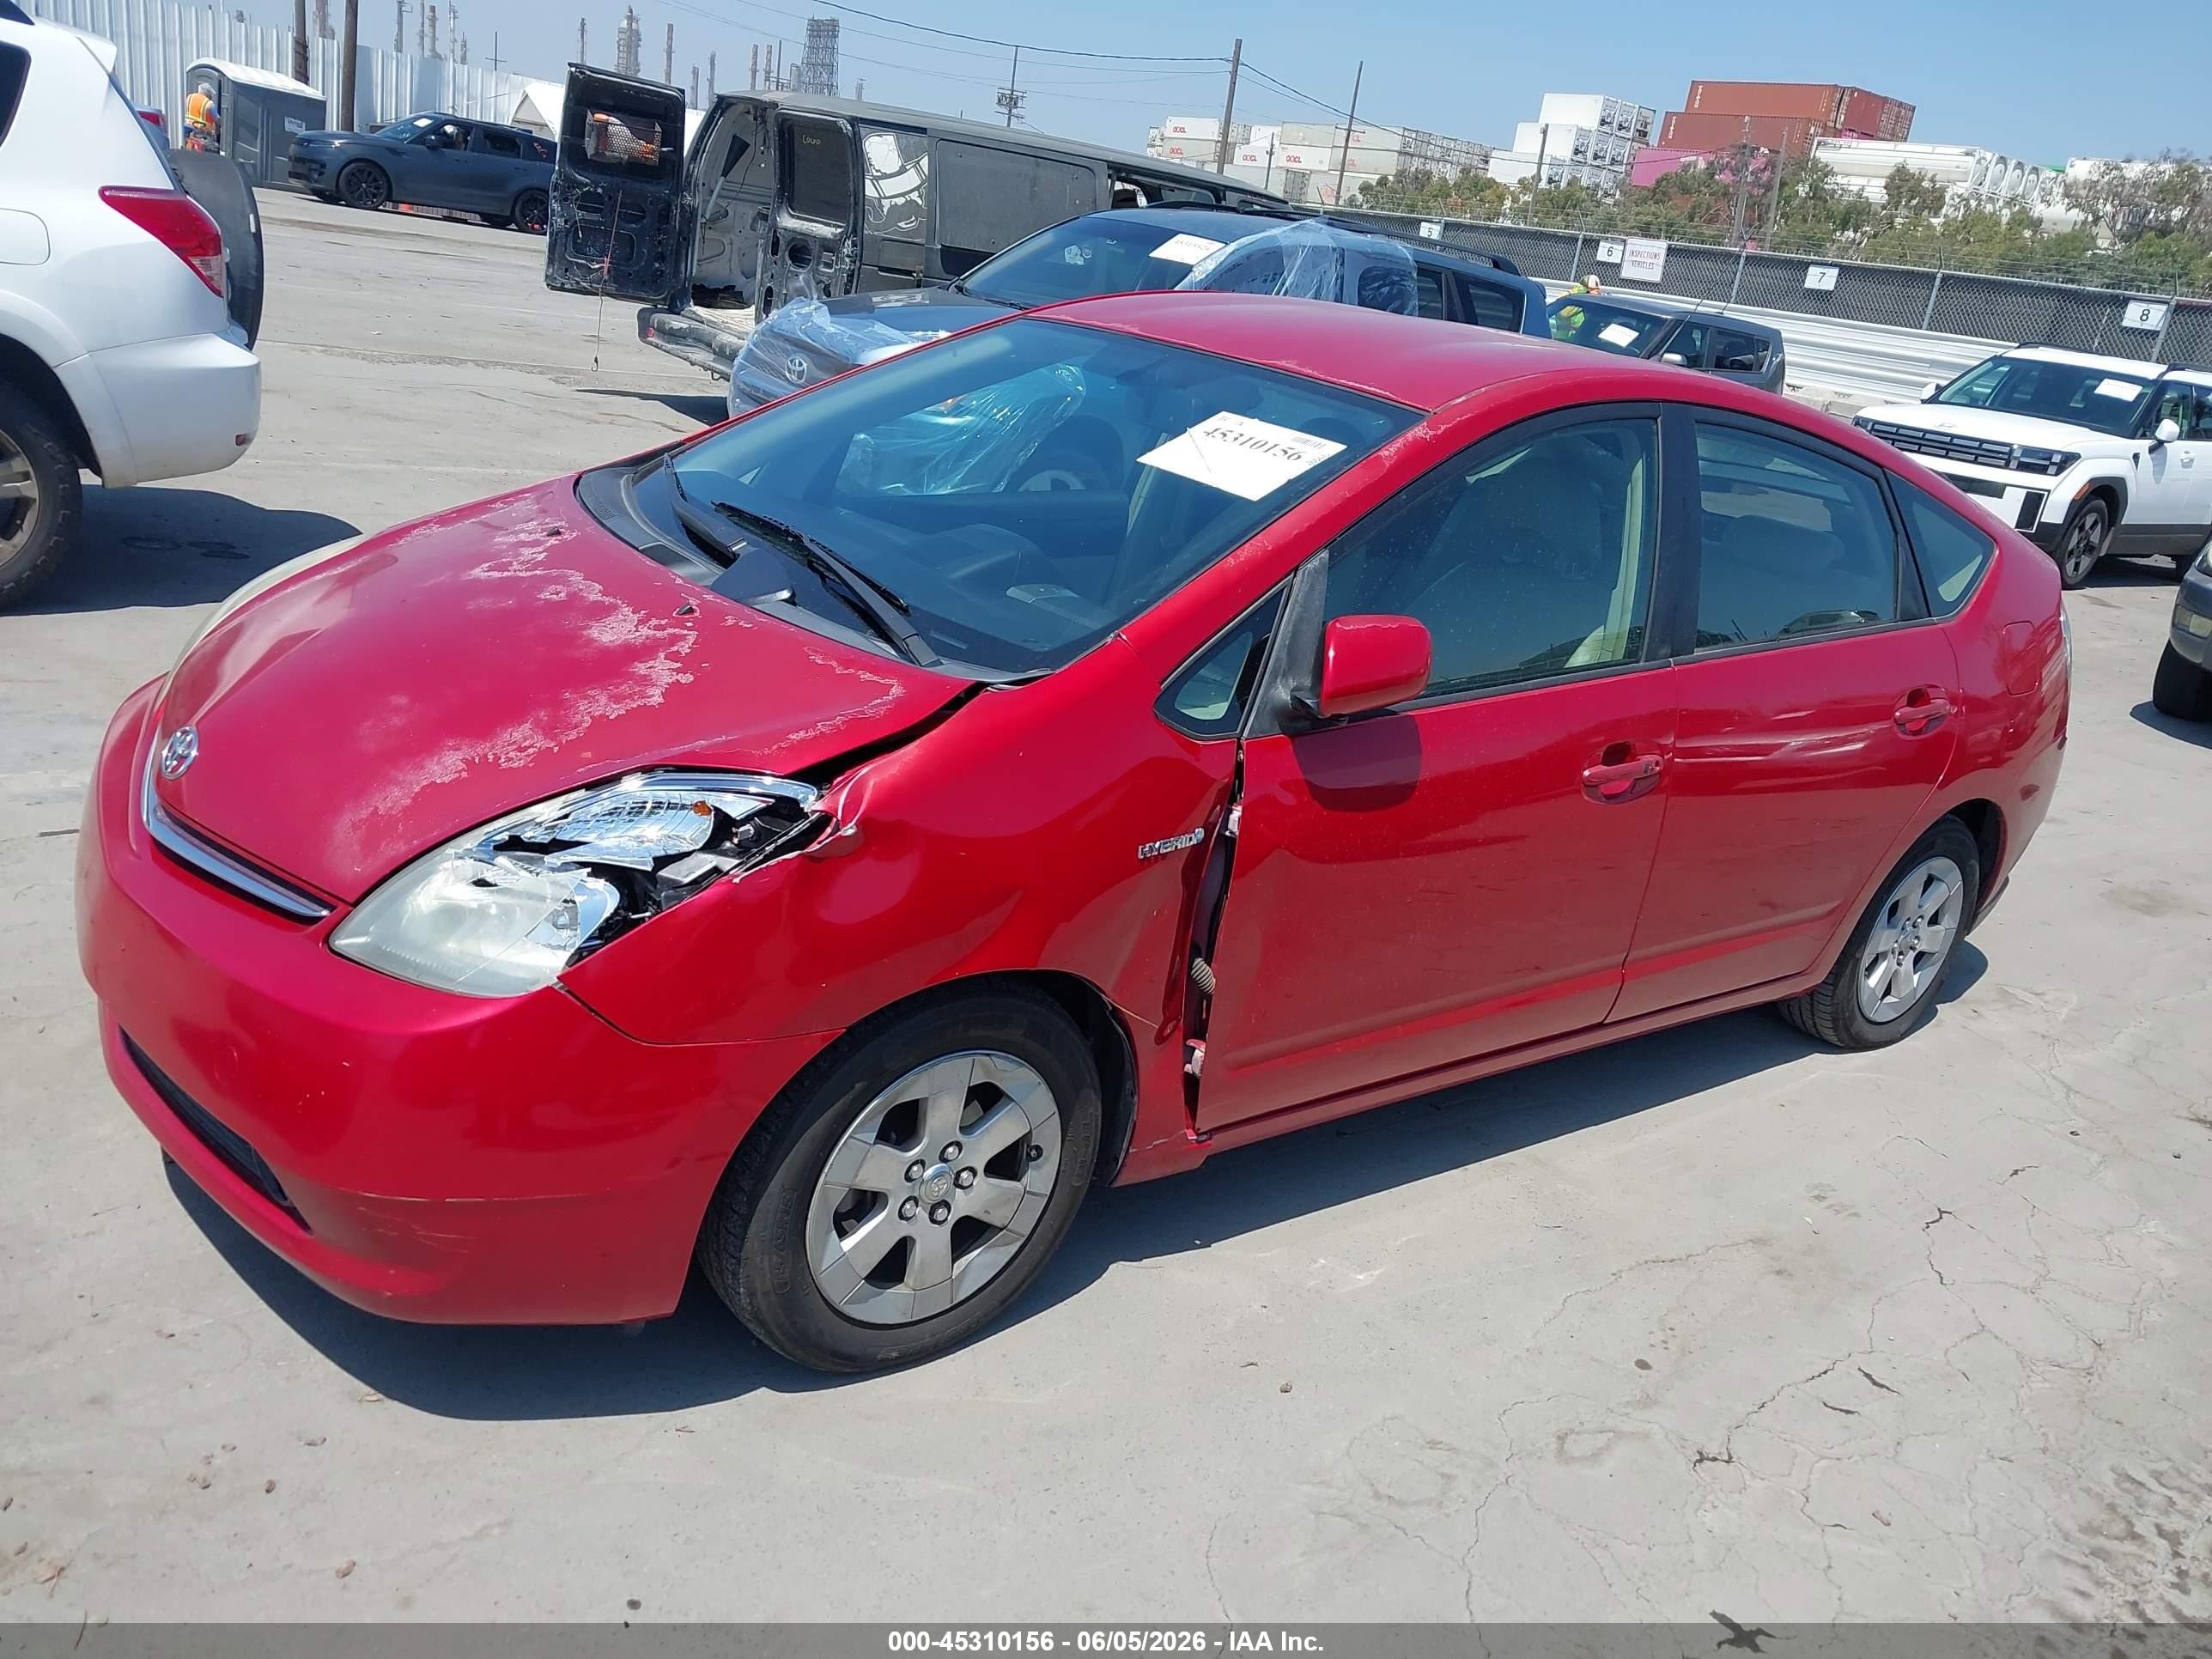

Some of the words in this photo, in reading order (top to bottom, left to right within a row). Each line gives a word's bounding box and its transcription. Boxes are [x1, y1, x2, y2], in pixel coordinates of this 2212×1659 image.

[1285, 155, 1302, 163] OOCL
[1607, 246, 1614, 257] 6
[1628, 249, 1662, 260] INSPECTIONS
[1818, 271, 1826, 283] 7
[2139, 308, 2151, 322] 8
[1203, 427, 1306, 461] 45310156
[1138, 831, 1198, 859] HYBRID
